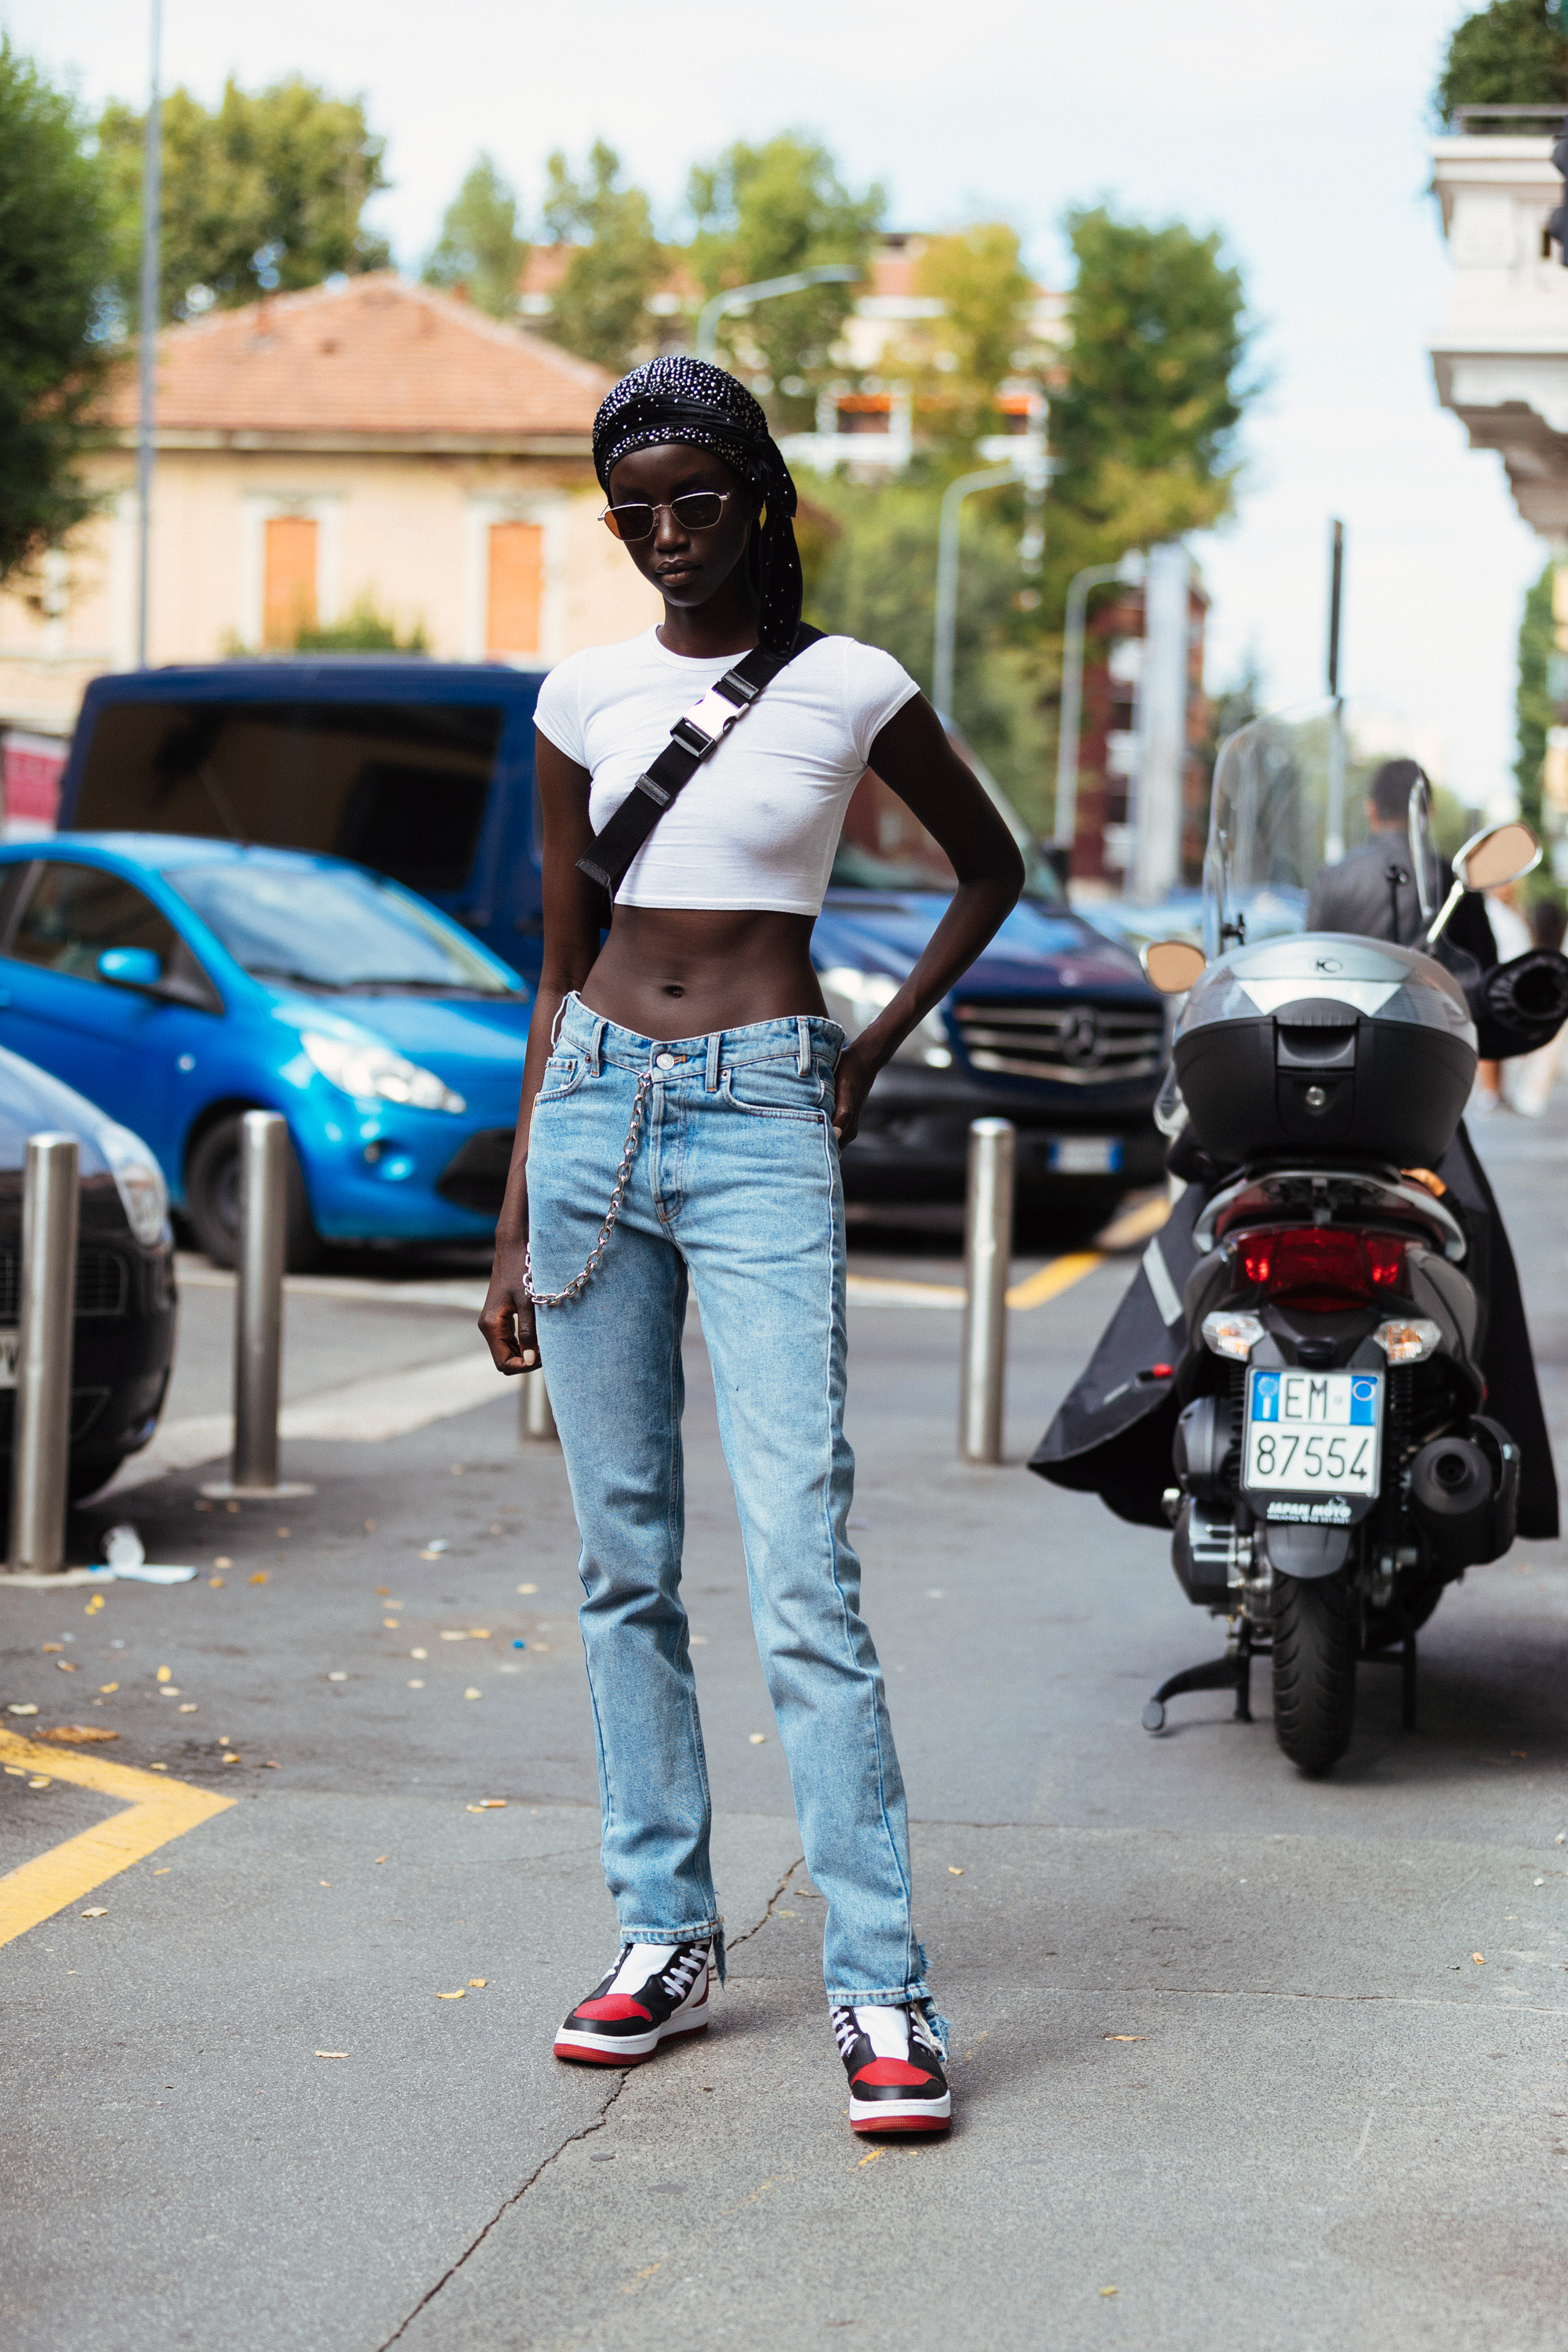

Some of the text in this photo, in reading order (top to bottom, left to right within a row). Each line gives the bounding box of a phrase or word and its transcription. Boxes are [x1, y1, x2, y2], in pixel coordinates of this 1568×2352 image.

[1285, 1378, 1328, 1419] EM
[1257, 1435, 1369, 1479] 87554
[1266, 1501, 1352, 1518] JAPAN MOTO
